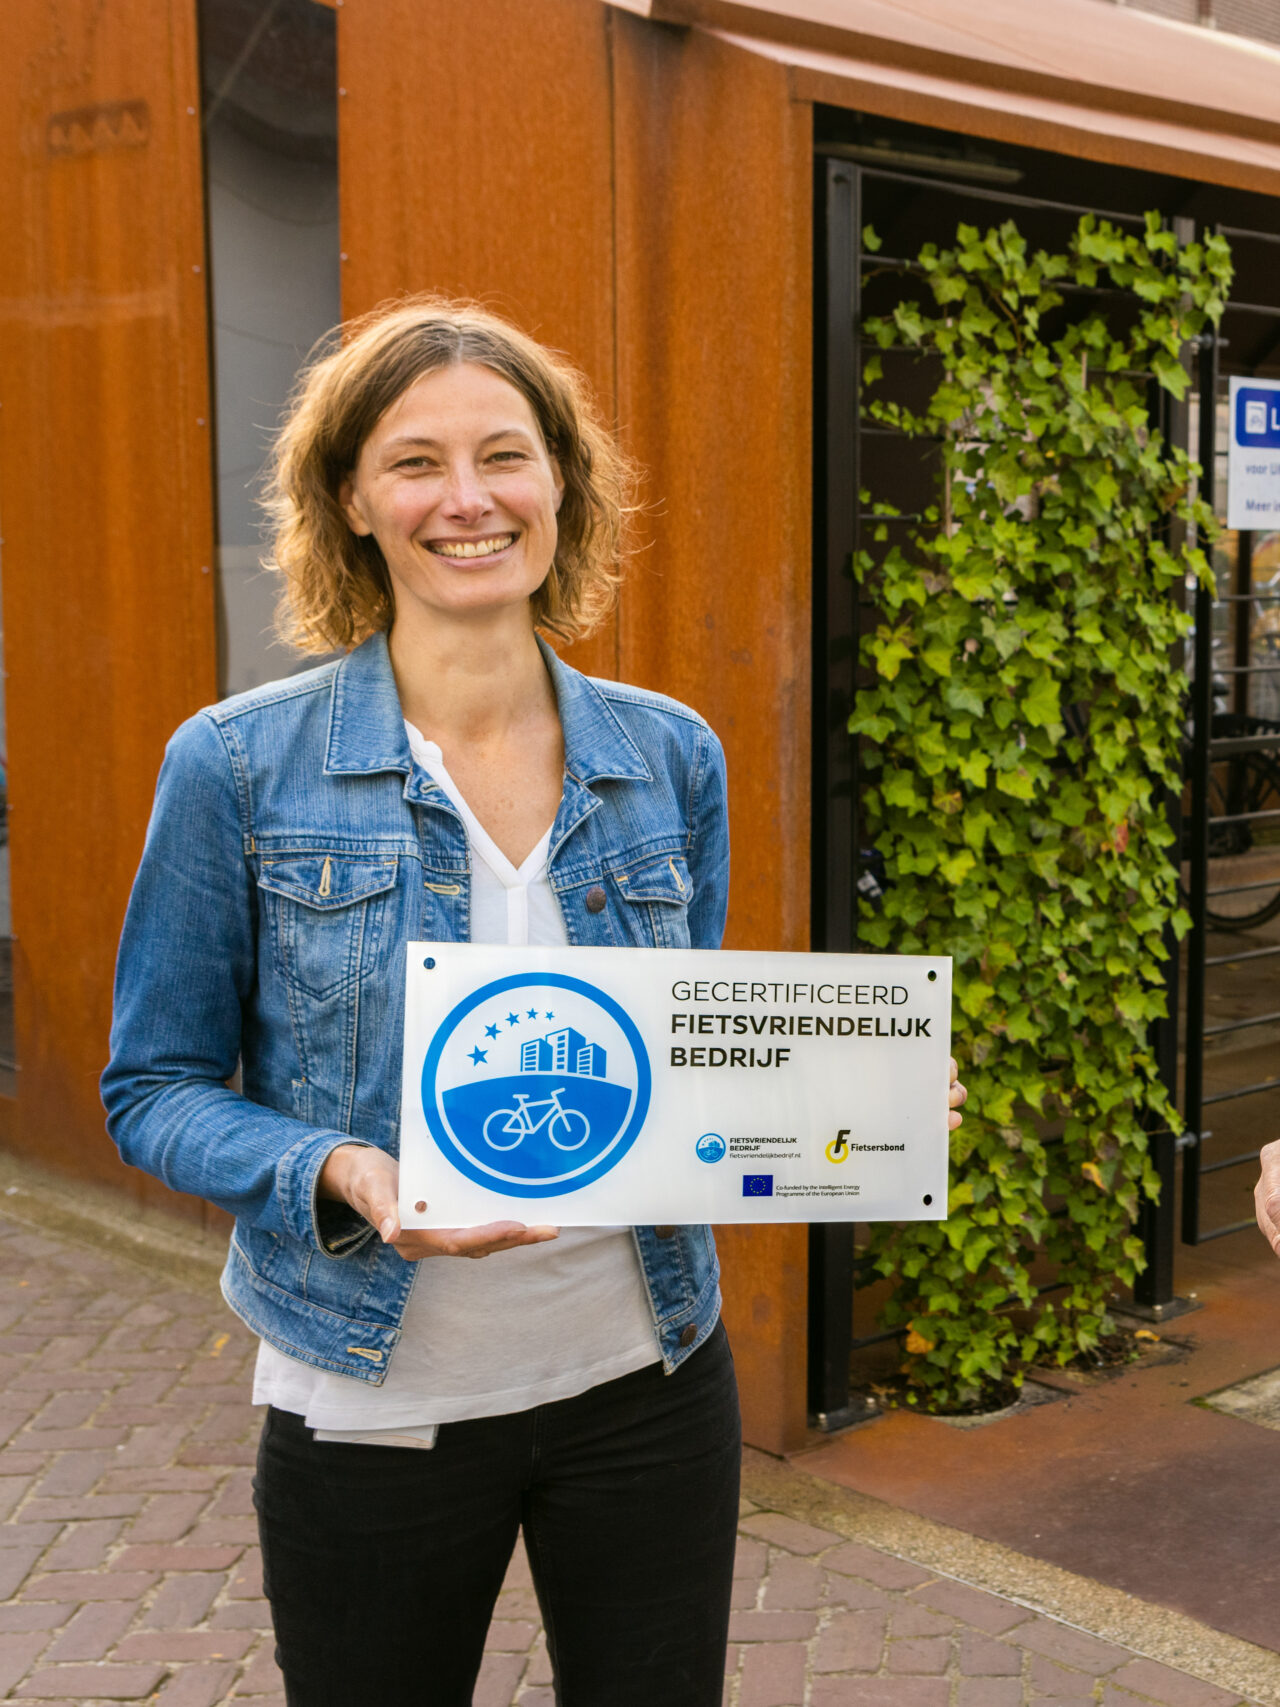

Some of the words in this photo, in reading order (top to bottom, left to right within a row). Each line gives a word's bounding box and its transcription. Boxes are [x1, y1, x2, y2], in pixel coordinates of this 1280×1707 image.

[1245, 464, 1267, 475] voor
[1245, 499, 1270, 512] Meer
[672, 981, 909, 1005] GECERTIFICEERD
[671, 1014, 932, 1037] FIETSVRIENDELIJK
[670, 1047, 791, 1068] BEDRIJF
[850, 1143, 905, 1152] Fietsersbond
[729, 1152, 801, 1160] fietsvriendelijkbedrijf.nl
[802, 1184, 809, 1192] by
[843, 1184, 860, 1192] Energy
